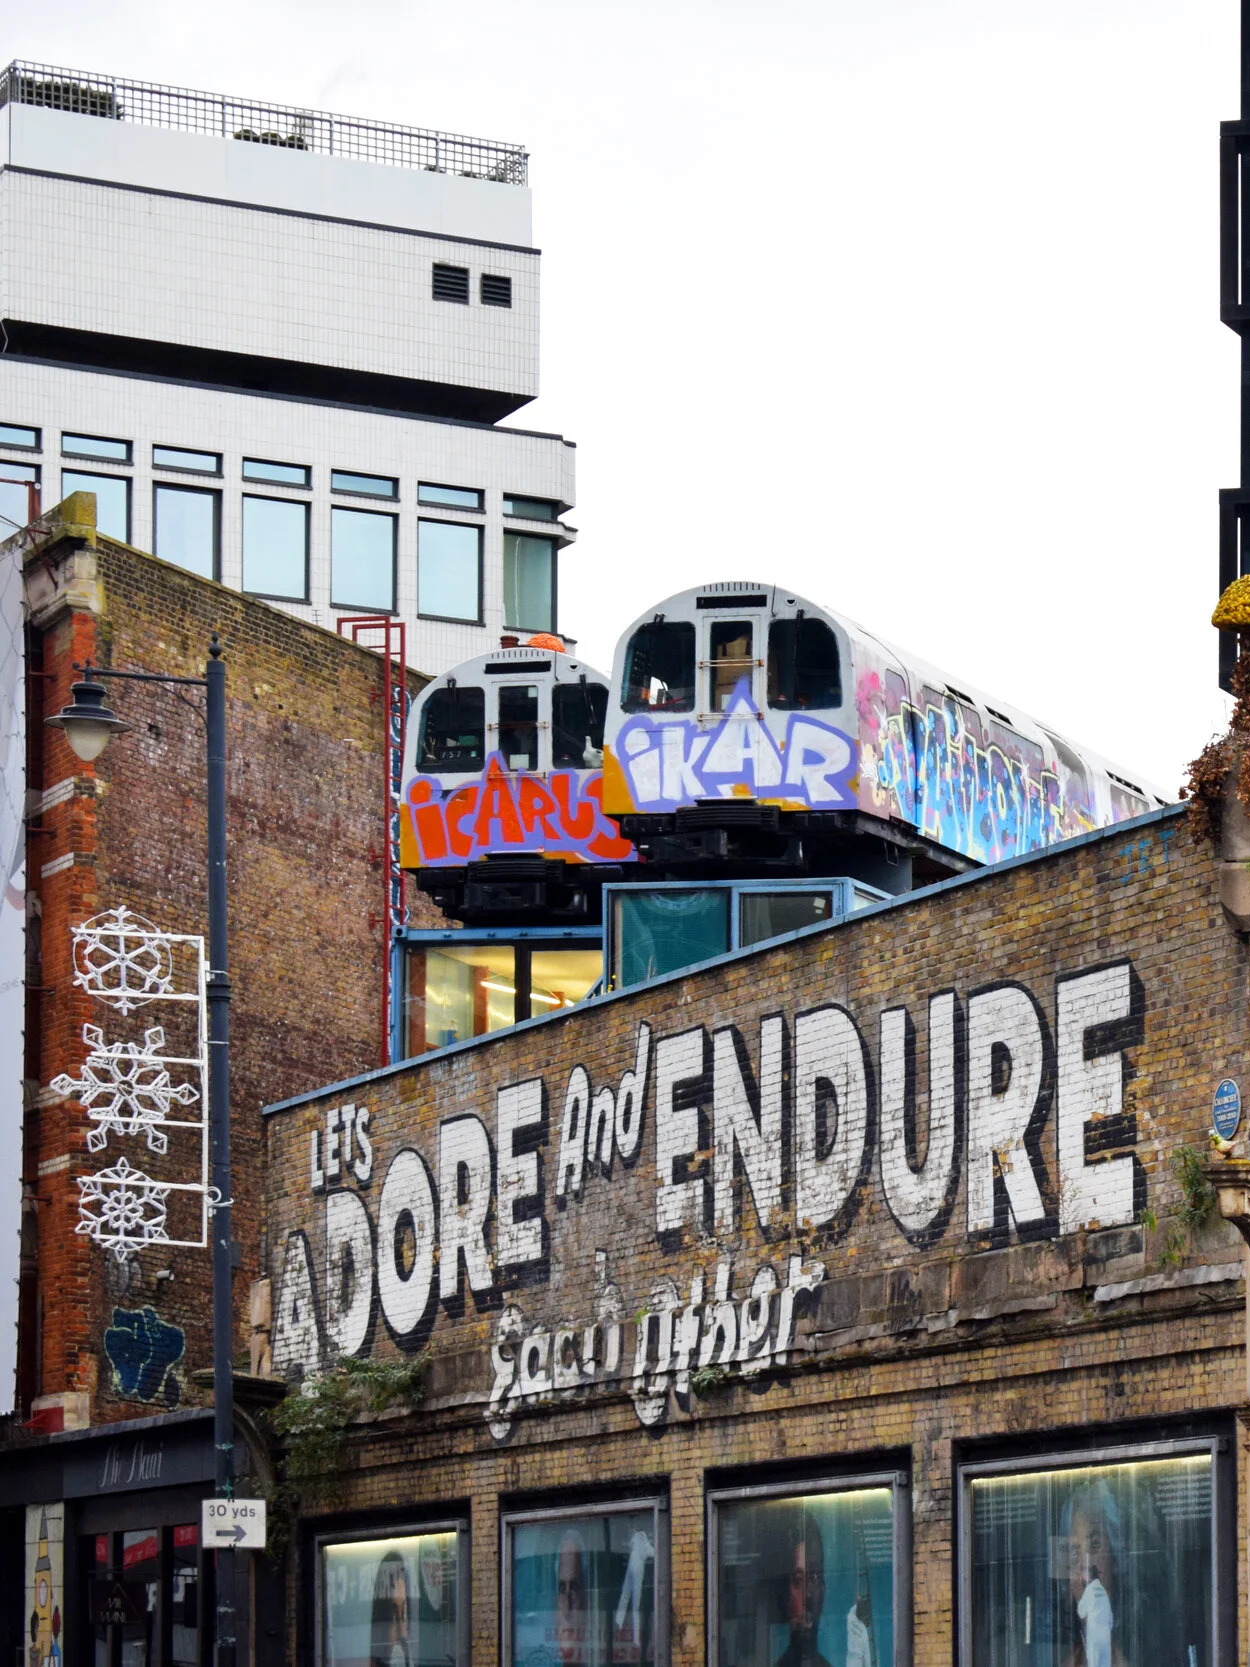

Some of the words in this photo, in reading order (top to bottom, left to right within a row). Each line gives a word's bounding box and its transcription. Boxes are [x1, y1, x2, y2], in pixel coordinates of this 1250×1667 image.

[310, 1102, 374, 1195] LETS
[655, 958, 1148, 1250] ENDURE
[272, 1077, 551, 1378] ADORE
[208, 1504, 227, 1517] 30
[231, 1504, 256, 1519] yds
